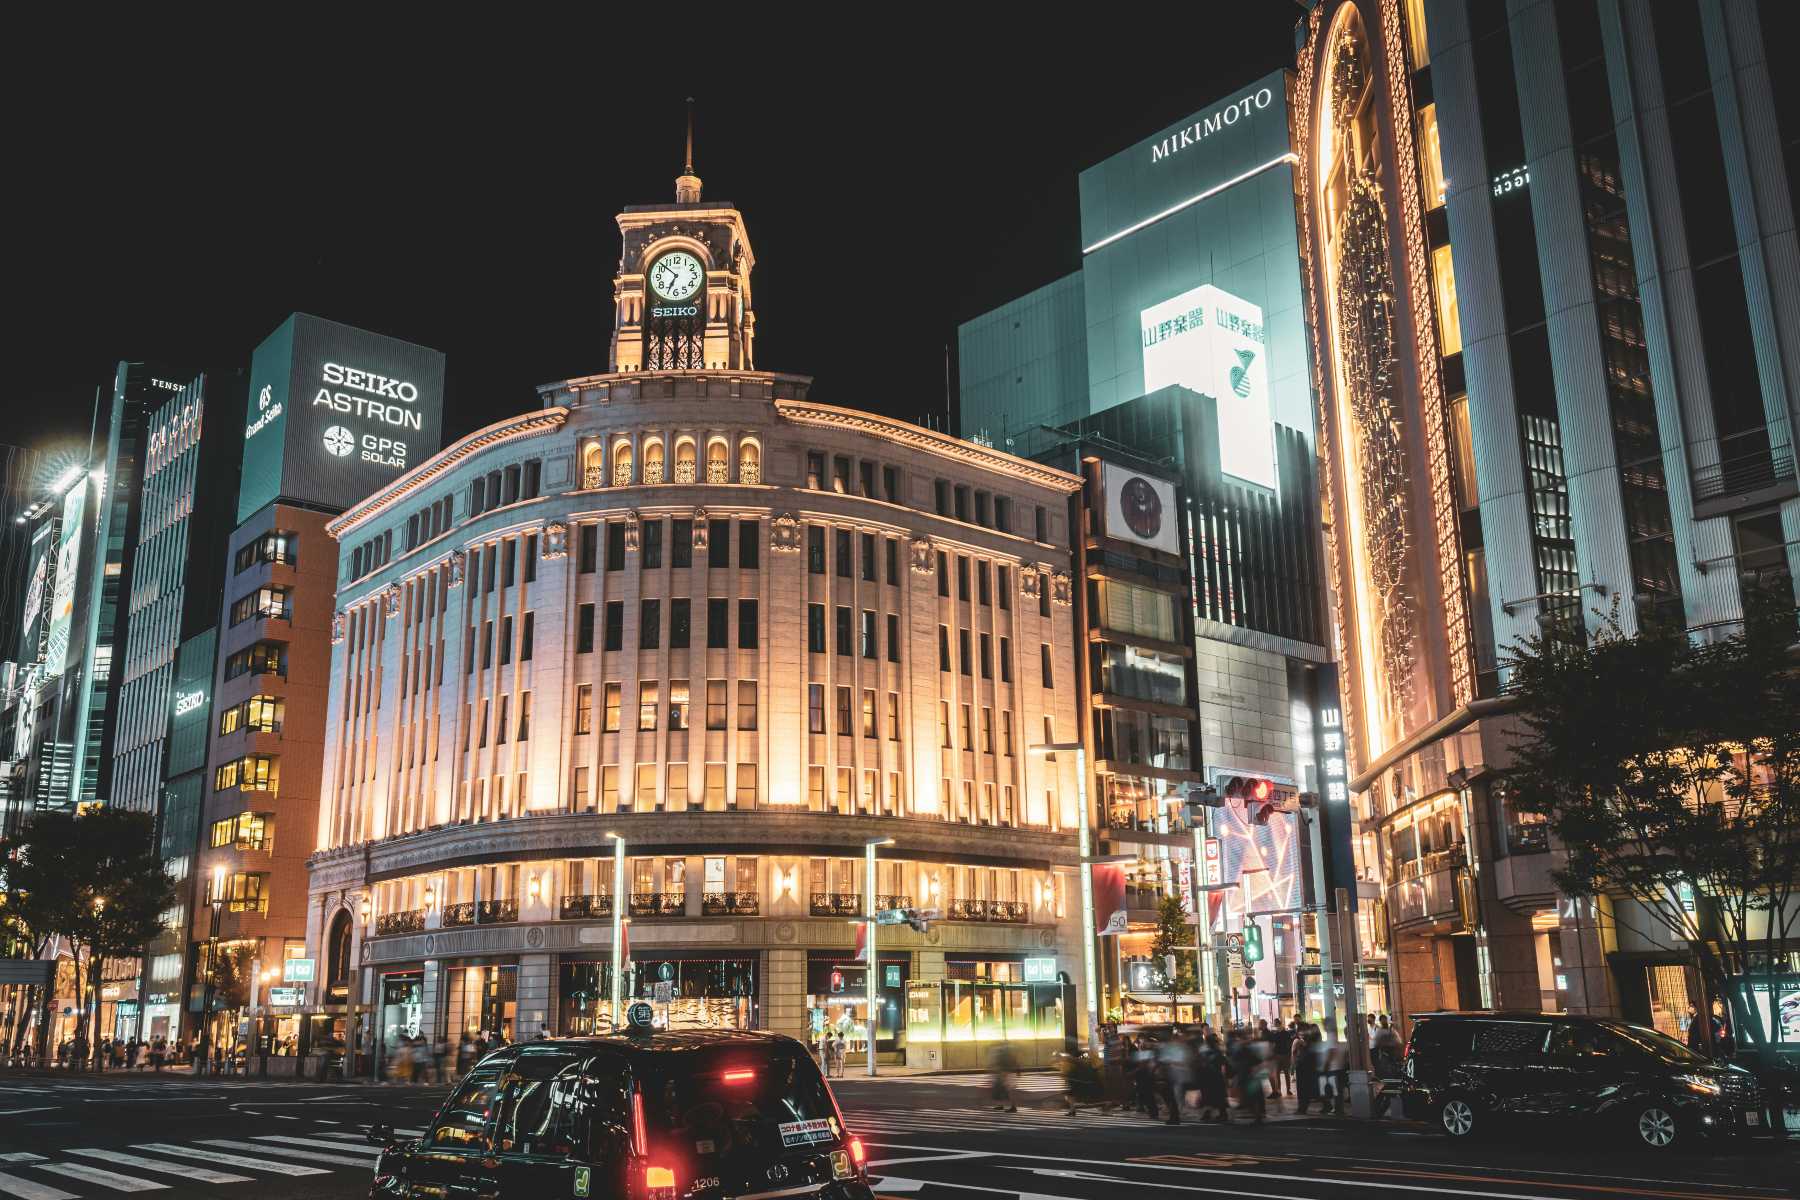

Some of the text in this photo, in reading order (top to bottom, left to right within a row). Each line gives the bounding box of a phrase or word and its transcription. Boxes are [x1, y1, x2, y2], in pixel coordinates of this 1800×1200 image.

[1152, 88, 1272, 163] MIKIMOTO
[673, 256, 681, 264] 12
[684, 258, 687, 266] 1
[689, 263, 695, 271] 2
[655, 273, 661, 281] 9
[691, 272, 698, 280] 3
[658, 281, 665, 289] 8
[688, 280, 694, 288] 4
[672, 288, 679, 296] 6
[681, 286, 688, 294] 5
[653, 307, 697, 317] SEIKO
[1143, 306, 1204, 348] 山野楽器
[1216, 306, 1265, 345] 山野楽器
[323, 362, 418, 402] SEIKO
[313, 388, 421, 431] ASTRON
[362, 434, 406, 457] GPS
[361, 450, 406, 469] SOLAR
[694, 1176, 720, 1189] 1206
